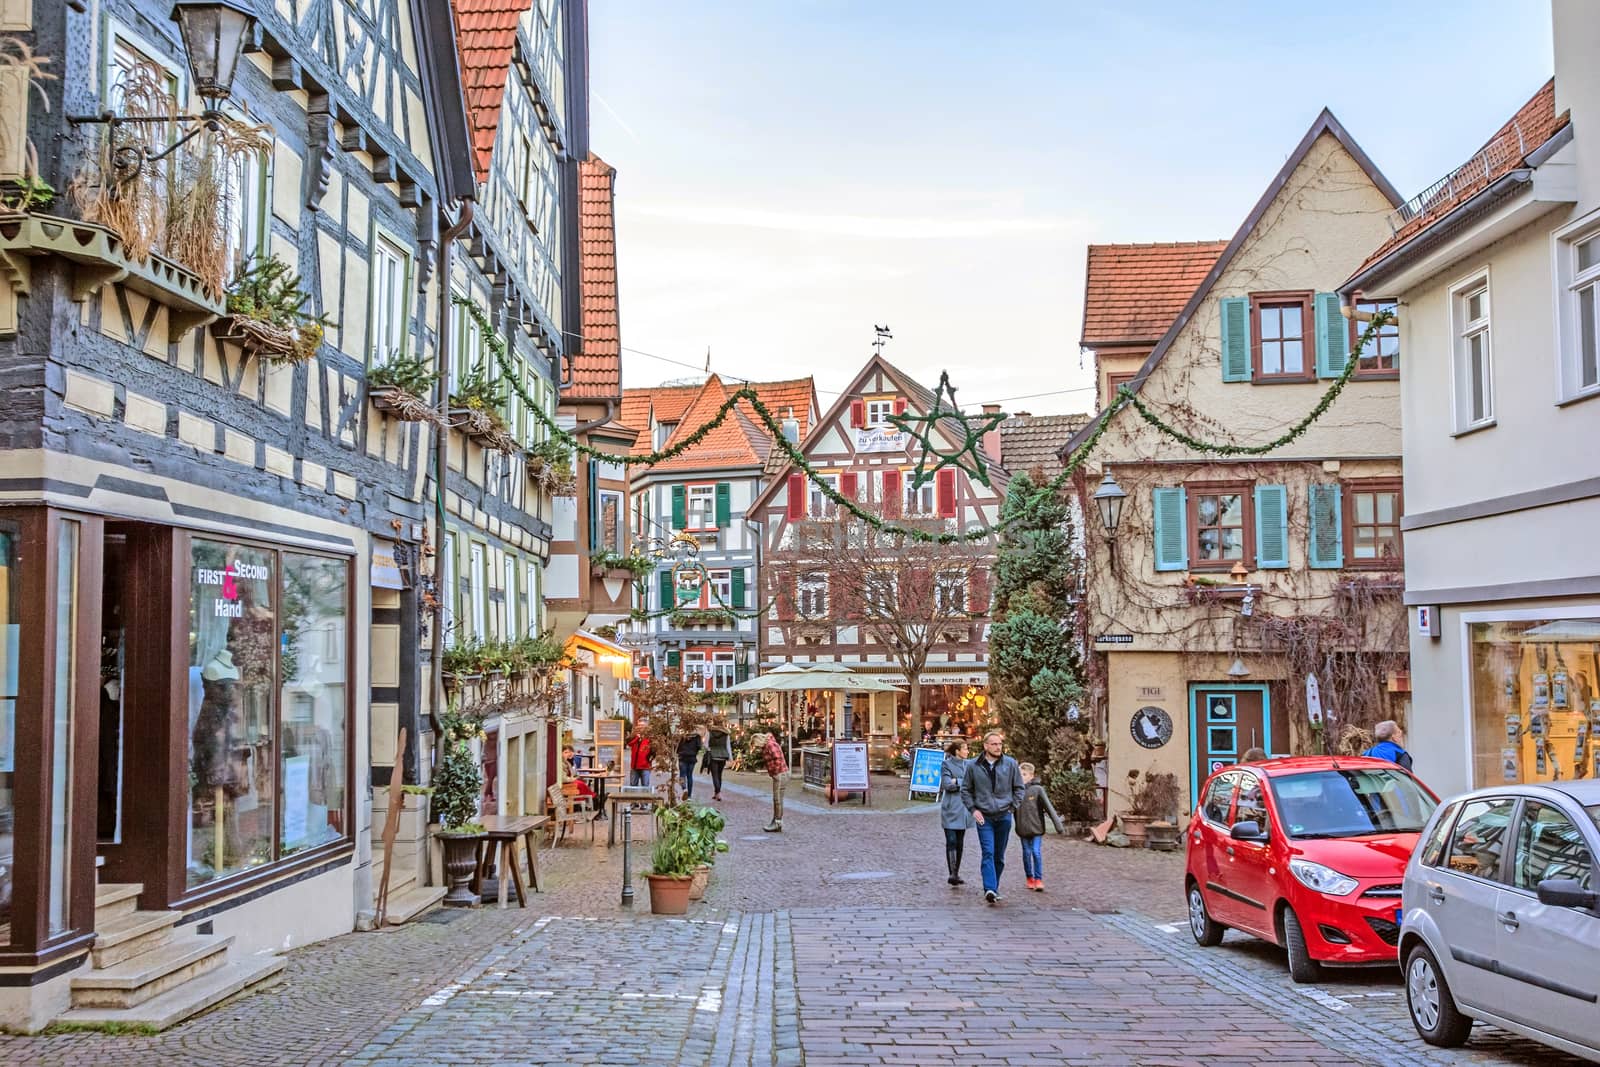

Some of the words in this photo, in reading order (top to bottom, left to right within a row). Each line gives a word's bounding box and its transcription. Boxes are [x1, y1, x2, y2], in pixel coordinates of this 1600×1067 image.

[198, 569, 226, 584] FIRST
[229, 560, 268, 580] SECOND
[223, 566, 238, 600] &
[215, 599, 242, 618] Hand
